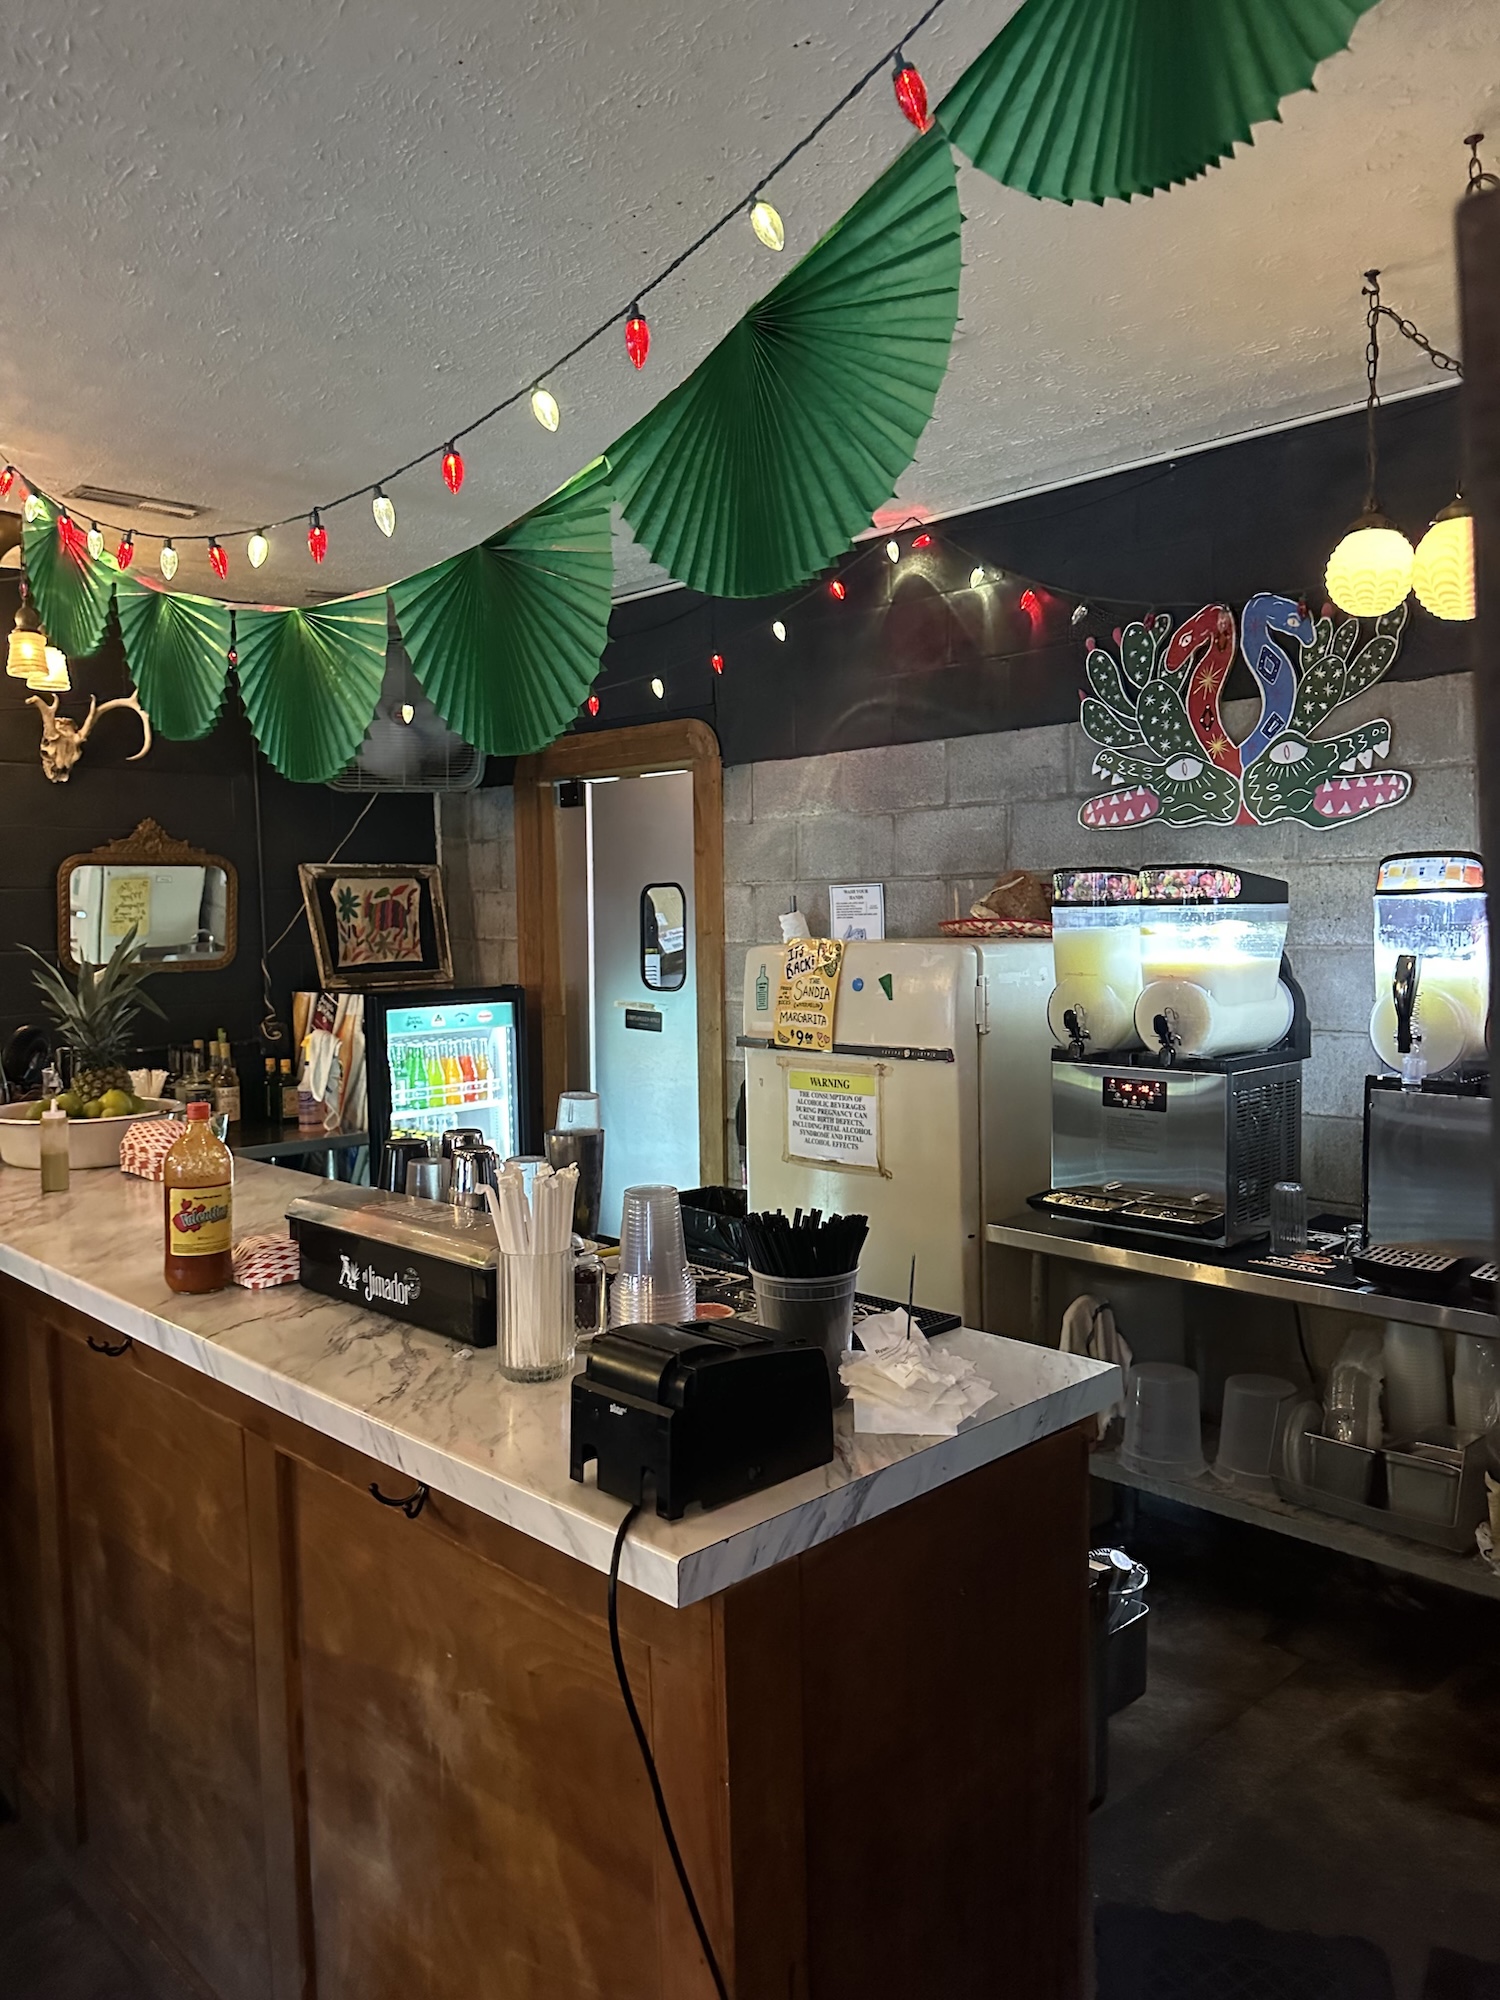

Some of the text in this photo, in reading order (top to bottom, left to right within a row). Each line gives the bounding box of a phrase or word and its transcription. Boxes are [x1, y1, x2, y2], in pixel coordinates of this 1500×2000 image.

[786, 955, 814, 980] BACK!
[794, 980, 830, 1000] SANDIA
[780, 1011, 828, 1026] MARGARITA
[810, 1076, 850, 1089] WARNING
[811, 1092, 852, 1101] CONSUMPTION
[797, 1098, 866, 1111] ALCOHOLIC BEVERAGES
[796, 1106, 816, 1114] DURING
[818, 1108, 853, 1118] PREGNANCY
[792, 1120, 872, 1136] INCLUDING FETAL ALCOHOL
[817, 1116, 834, 1124] BIRTH
[836, 1118, 864, 1127] DEFECTS,
[800, 1129, 830, 1138] SYNDROME
[844, 1134, 864, 1142] FETAL
[804, 1138, 858, 1150] ALCOHOL EFFECTS
[365, 1264, 411, 1306] Jimador
